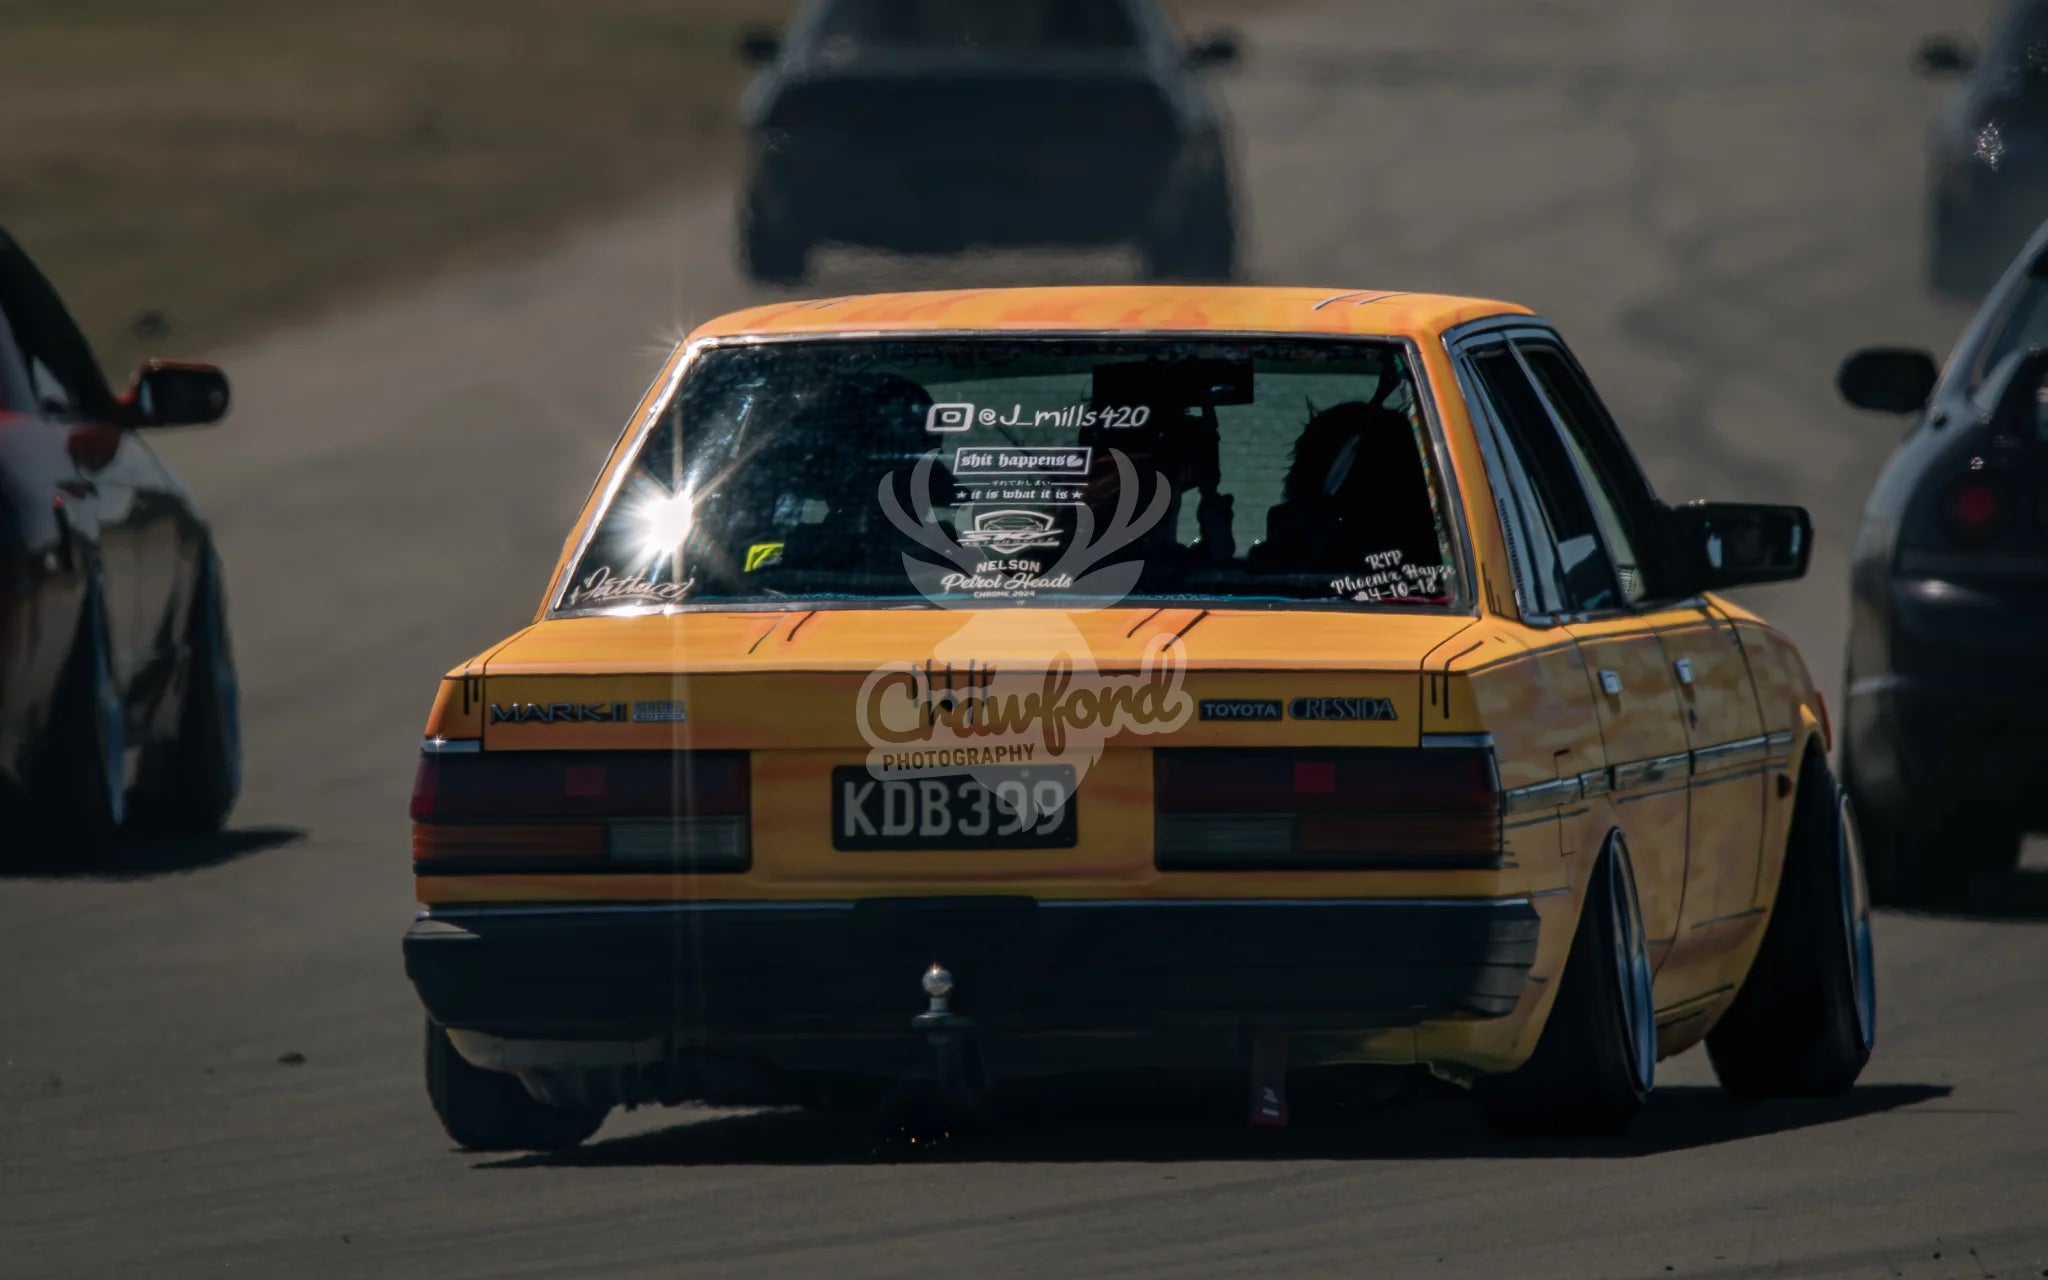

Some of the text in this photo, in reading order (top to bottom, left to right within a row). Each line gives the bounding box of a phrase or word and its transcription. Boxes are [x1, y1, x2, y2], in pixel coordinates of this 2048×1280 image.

[978, 403, 1151, 429] @J_mills420
[961, 453, 1067, 468] shit happens
[971, 488, 1069, 499] it is what it is
[976, 560, 1040, 573] NELSON
[1364, 550, 1403, 570] RIP
[940, 572, 1073, 595] Petrol Heads
[1203, 704, 1278, 717] TOYOTA
[1288, 697, 1398, 720] CRESSIDA
[844, 780, 1066, 836] KDB399
